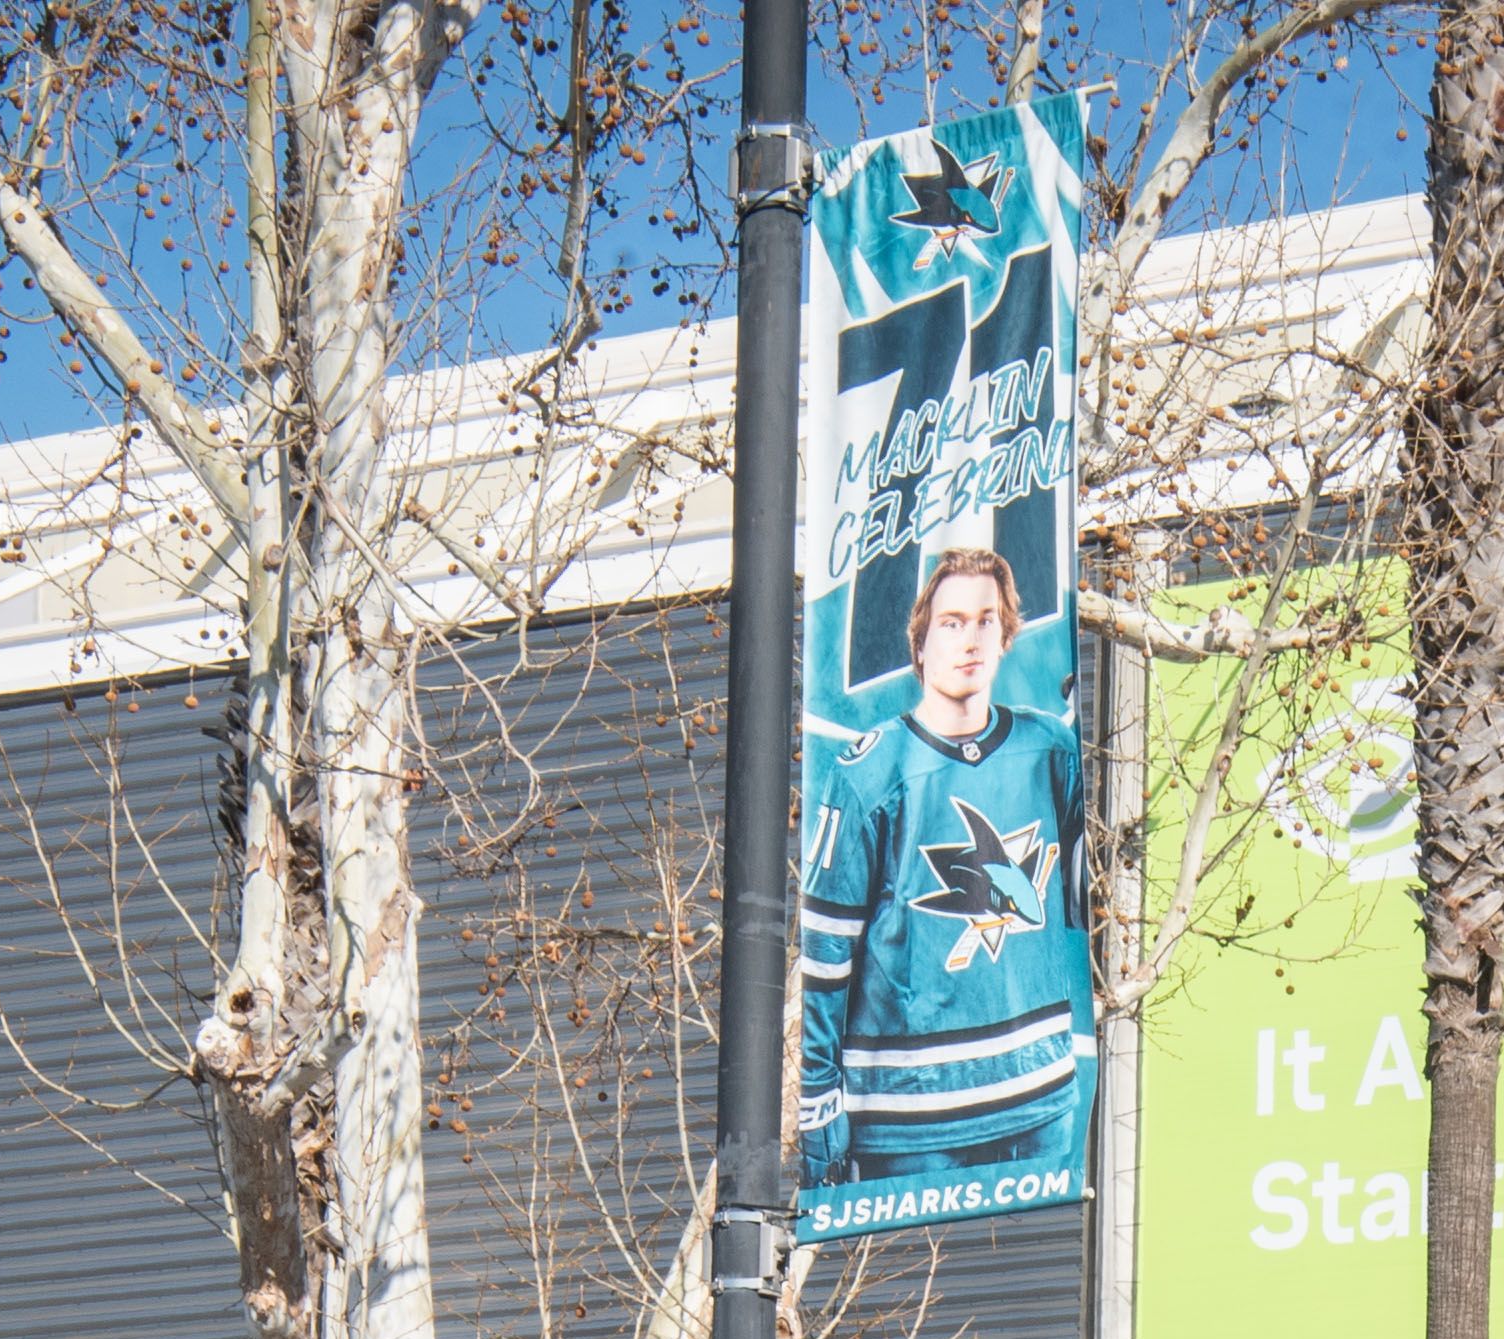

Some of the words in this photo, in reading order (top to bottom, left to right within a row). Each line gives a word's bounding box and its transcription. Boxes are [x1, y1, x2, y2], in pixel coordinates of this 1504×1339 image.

[834, 346, 1052, 505] MACKLIN
[829, 417, 1075, 578] CELEBRINI
[1255, 1028, 1326, 1116] It
[812, 1169, 1070, 1232] SJSHARKS.COM
